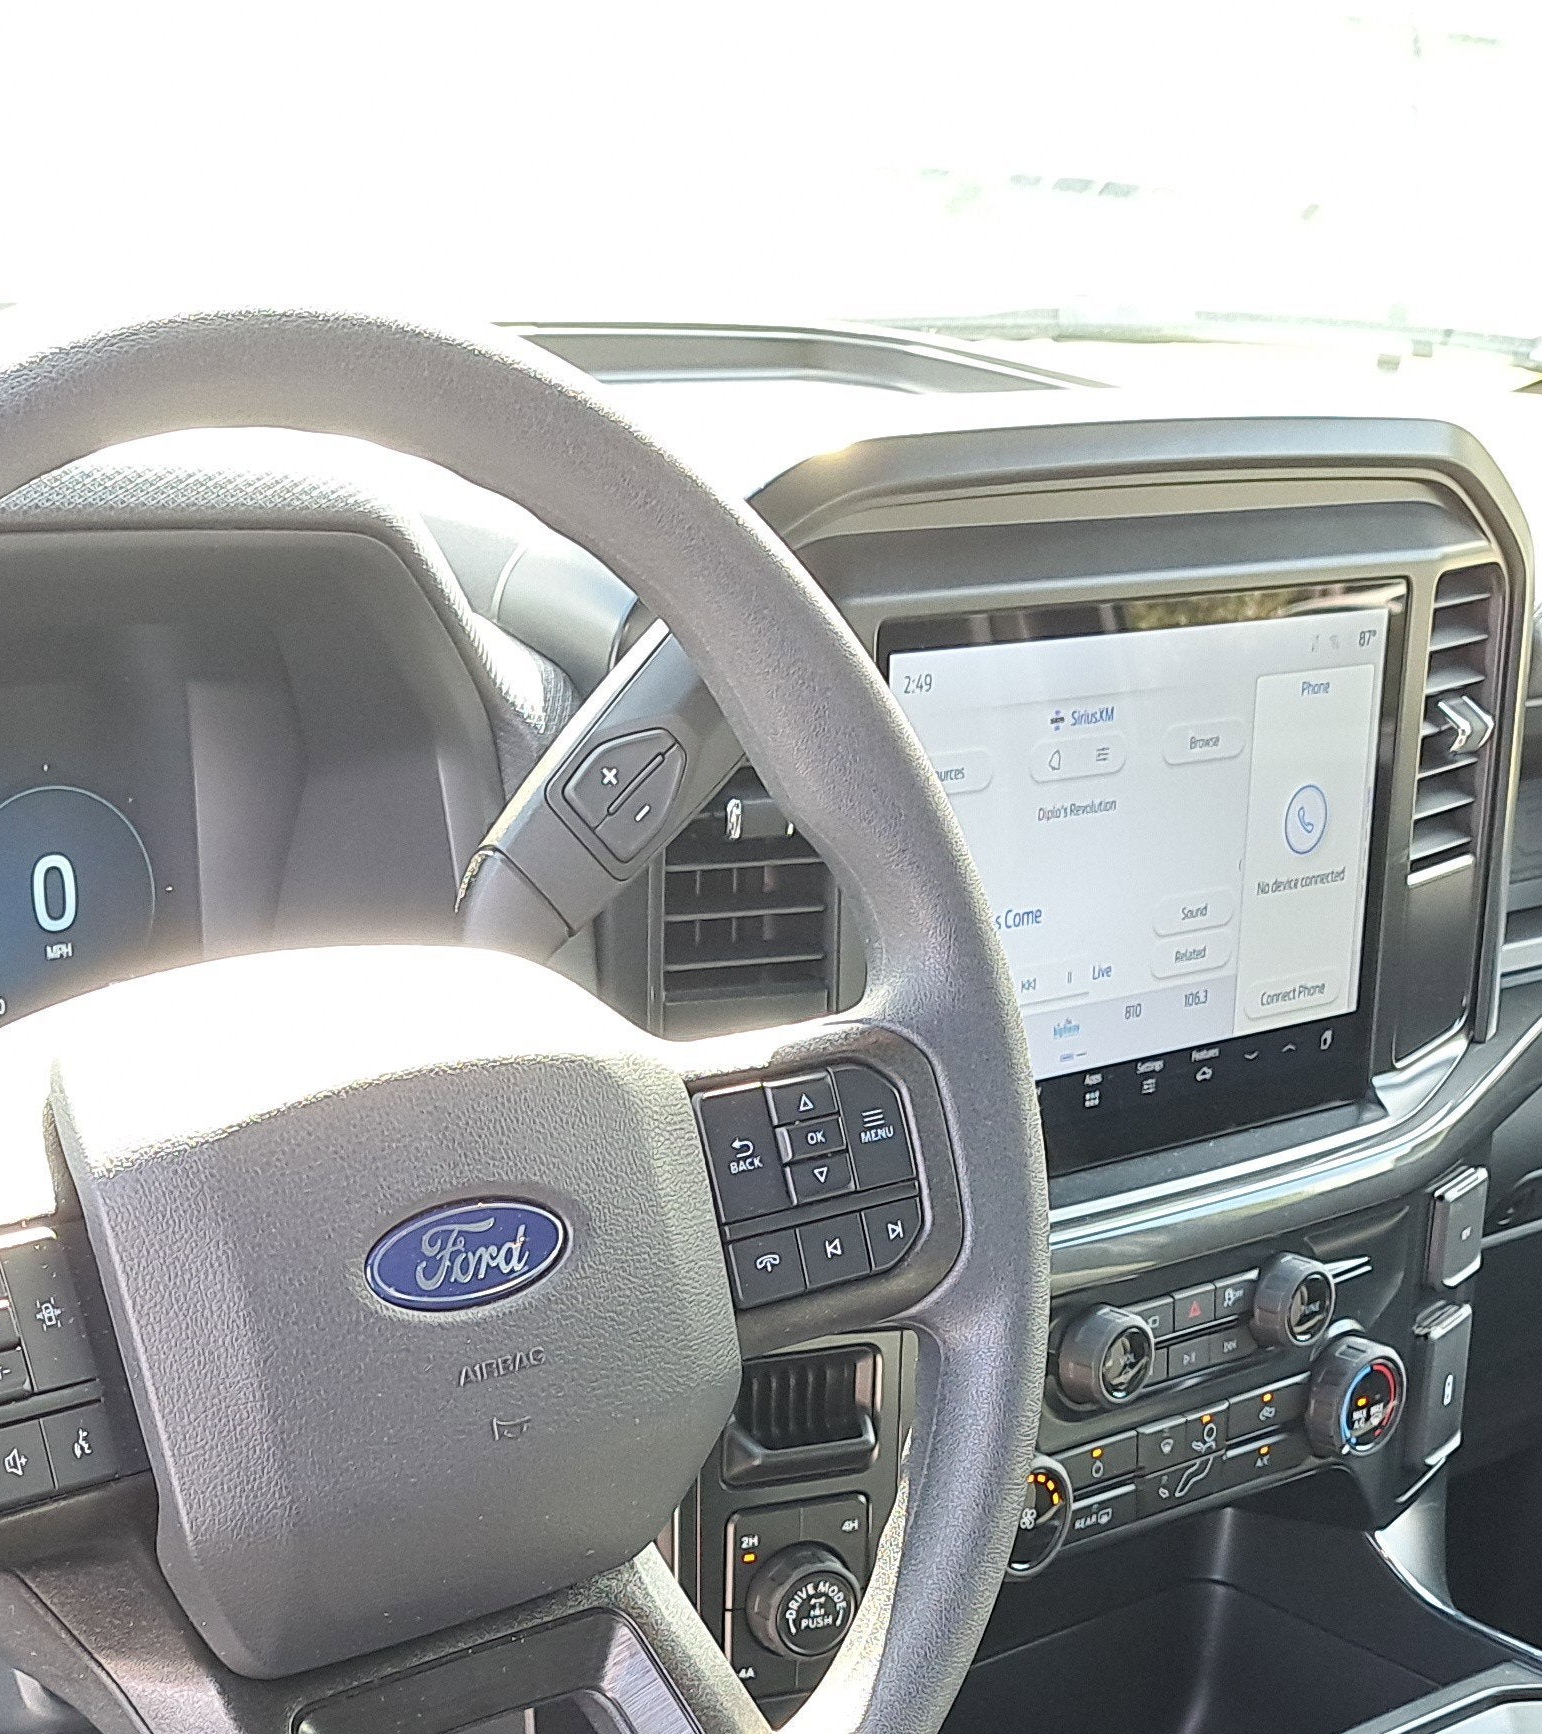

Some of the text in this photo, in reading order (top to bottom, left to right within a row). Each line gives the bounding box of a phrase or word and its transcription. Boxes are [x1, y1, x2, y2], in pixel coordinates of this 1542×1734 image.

[903, 673, 932, 694] 2:49
[1301, 681, 1330, 696] Phone
[1071, 706, 1115, 726] SiriusXM
[1189, 735, 1220, 750] Browse
[1069, 800, 1117, 817] Revolution
[1256, 866, 1346, 896] No device connected
[33, 854, 76, 932] 0
[1005, 908, 1042, 929] Come
[1181, 903, 1208, 920] Sound
[46, 942, 73, 960] MPH
[1174, 946, 1207, 963] Related
[1092, 965, 1112, 981] Live
[1184, 989, 1208, 1007] 106.3
[1260, 982, 1326, 1007] Connect Phone
[808, 1131, 826, 1146] OK
[861, 1126, 894, 1144] MENU
[730, 1156, 763, 1175] BACK
[415, 1216, 529, 1292] Ford
[458, 1346, 546, 1388] AIRBAG
[841, 1519, 859, 1533] 4H
[1074, 1514, 1097, 1530] REAR
[740, 1534, 758, 1549] 2H
[785, 1580, 848, 1619] DRIVE MODE
[800, 1616, 833, 1630] PUSH
[739, 1668, 755, 1680] 4A
